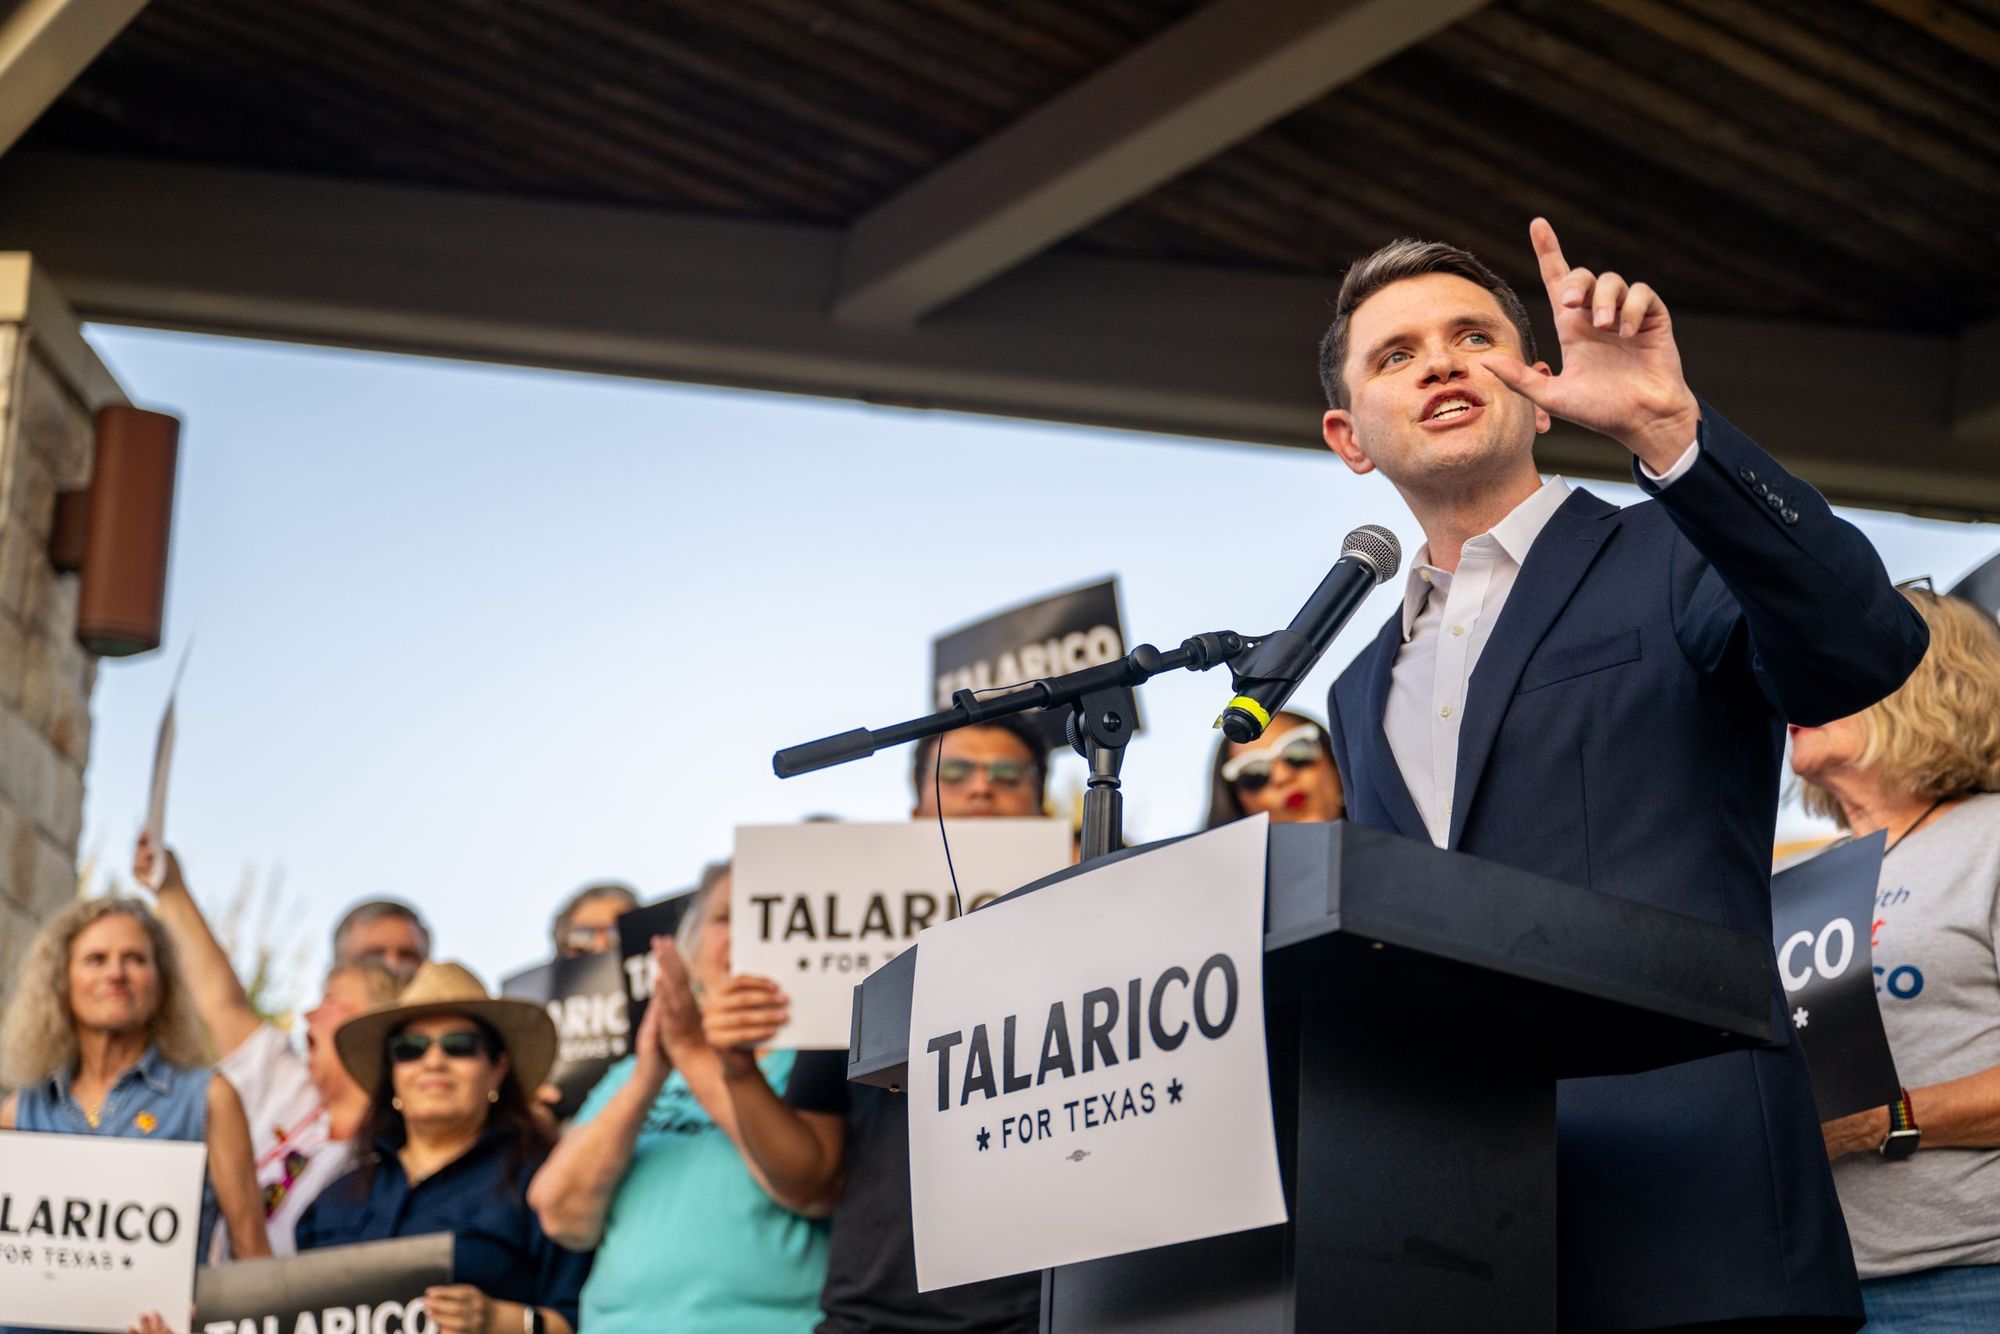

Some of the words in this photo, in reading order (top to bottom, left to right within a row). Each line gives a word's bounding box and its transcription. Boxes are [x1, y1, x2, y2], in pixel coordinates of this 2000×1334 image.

[750, 891, 999, 940] TALARI
[821, 952, 869, 973] FOR
[1778, 917, 1855, 992] CO
[926, 953, 1239, 1112] TALARICO
[1002, 1108, 1052, 1149] FOR
[1063, 1081, 1156, 1132] TEXAS
[42, 1245, 113, 1272] TEXAS
